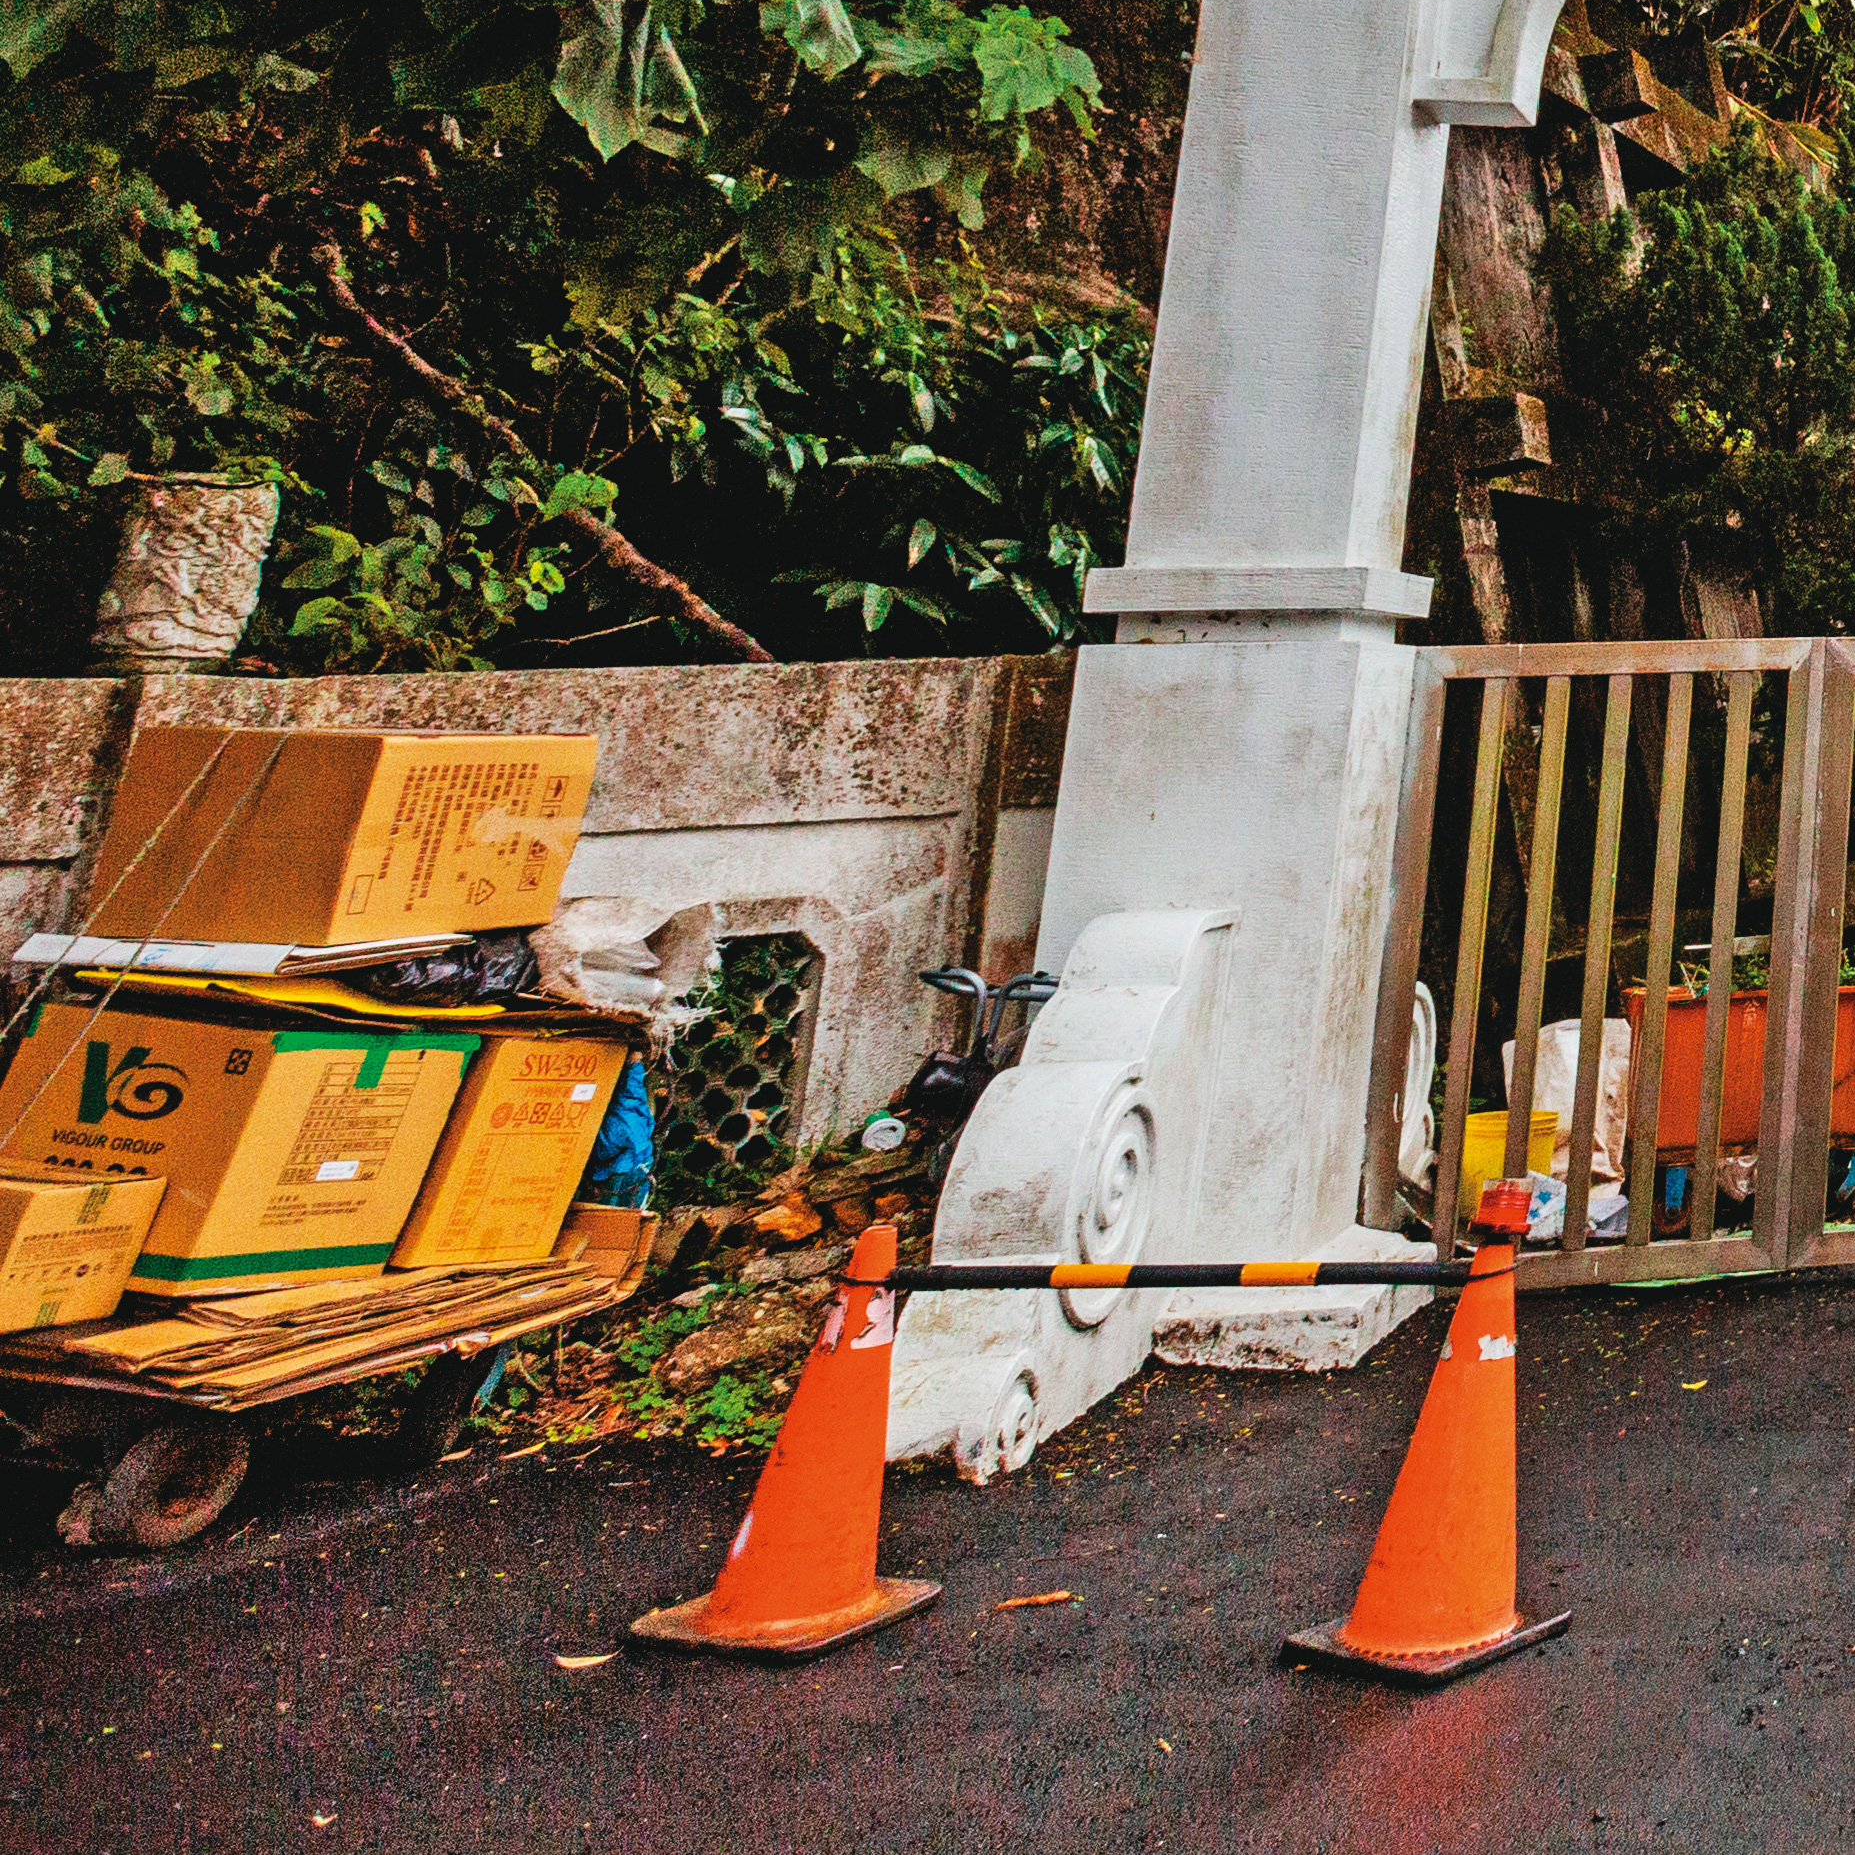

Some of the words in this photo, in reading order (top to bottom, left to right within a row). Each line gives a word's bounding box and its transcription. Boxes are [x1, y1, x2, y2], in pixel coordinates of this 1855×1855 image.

[519, 1053, 598, 1078] SW-390
[52, 1129, 109, 1149] VIGOUR
[111, 1136, 166, 1155] GROUP
